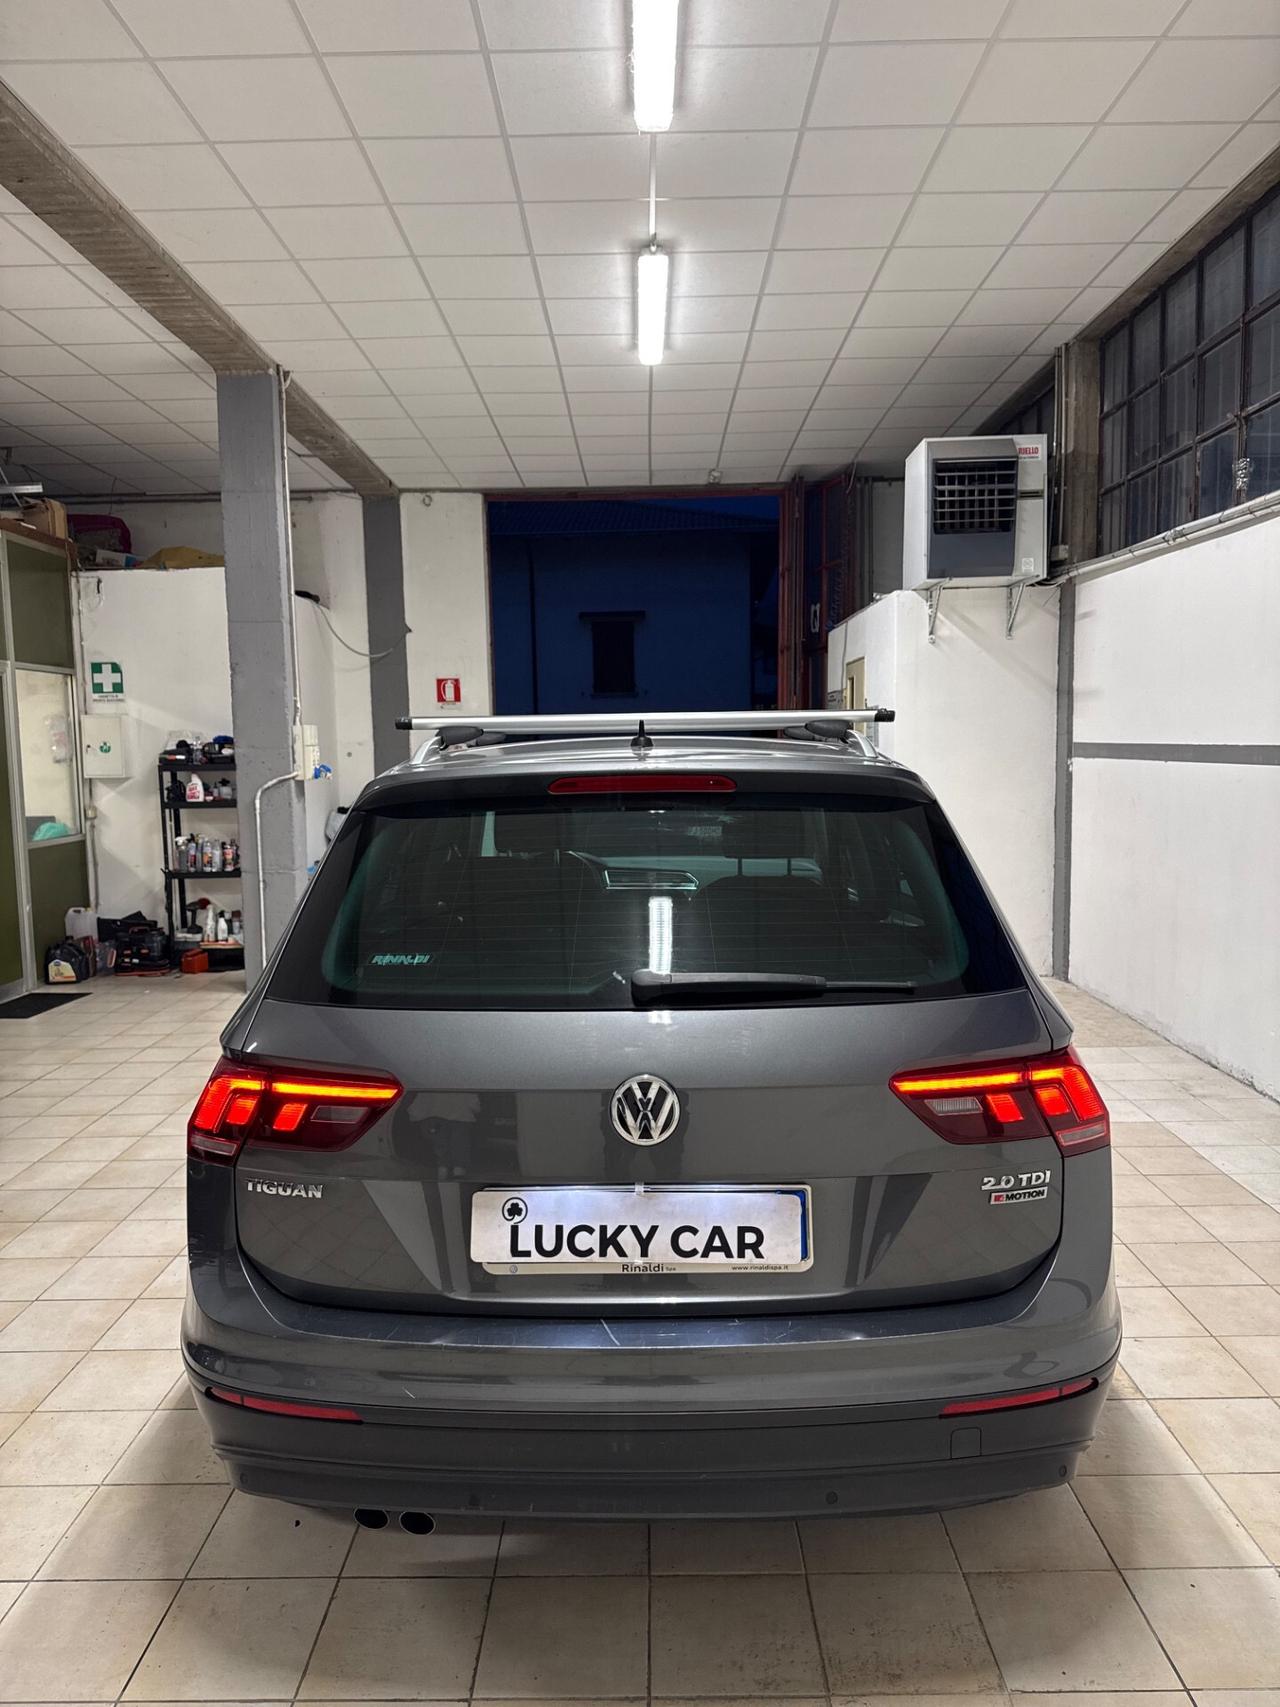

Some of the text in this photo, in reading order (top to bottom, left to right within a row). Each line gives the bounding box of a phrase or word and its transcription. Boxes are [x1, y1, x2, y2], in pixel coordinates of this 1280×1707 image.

[245, 1177, 323, 1199] TIGUAN
[1018, 1169, 1051, 1187] TDI
[510, 1224, 765, 1259] LUCKY CAR
[621, 1263, 664, 1273] Rinaldi
